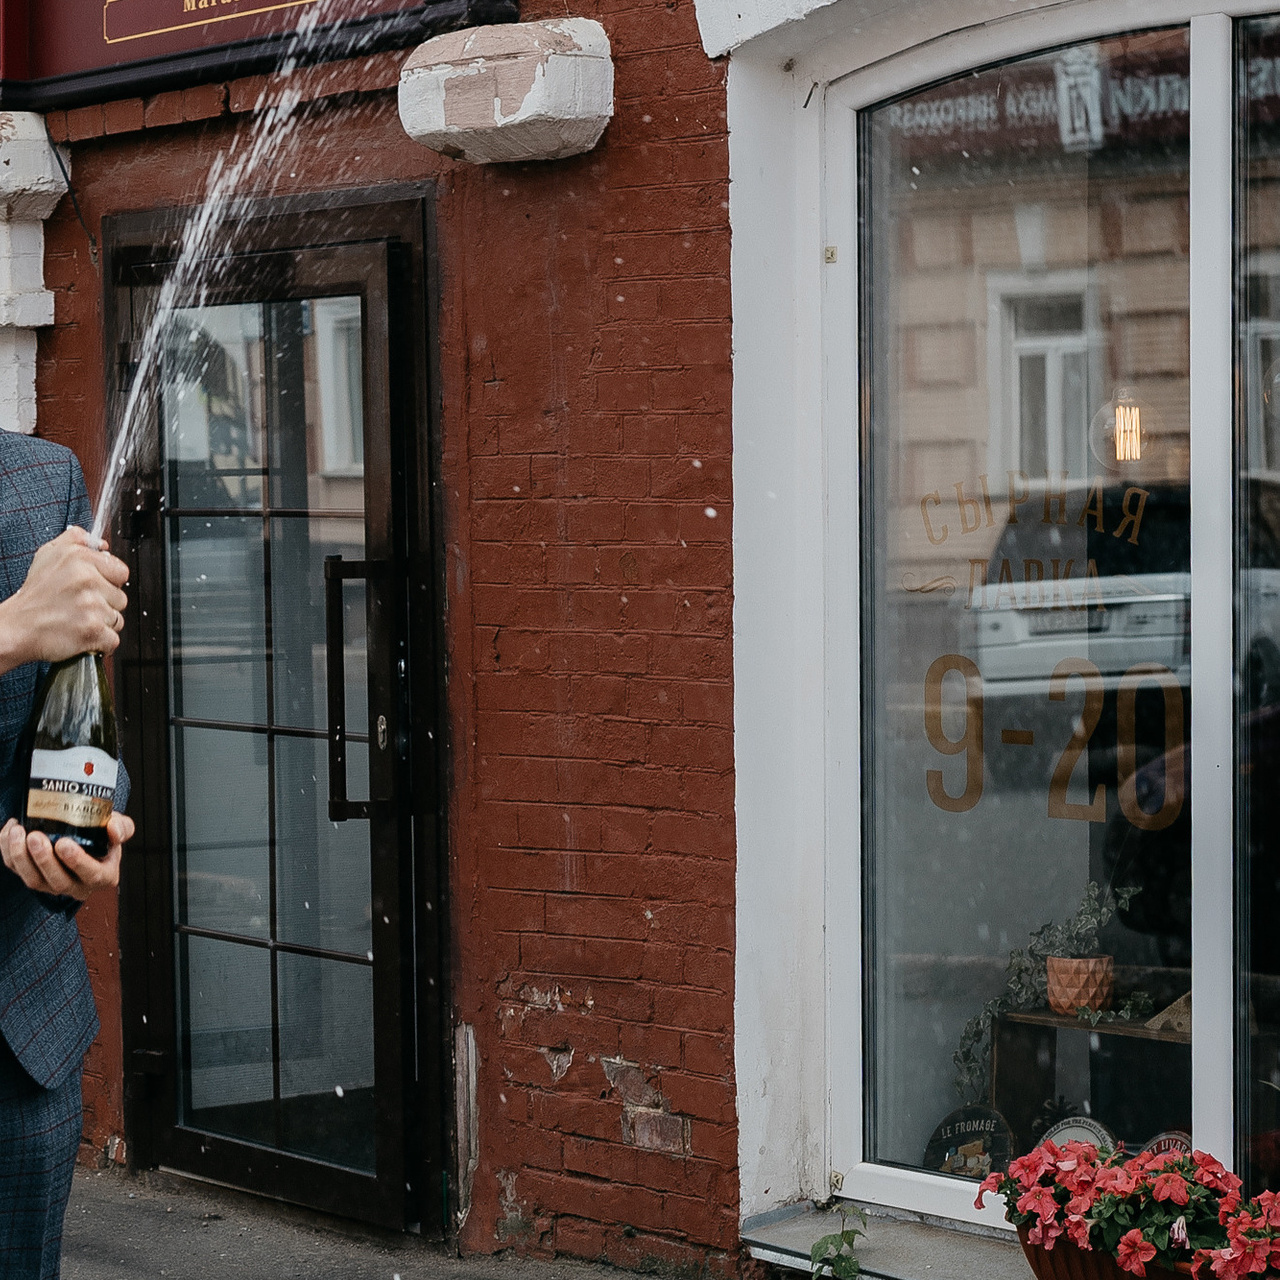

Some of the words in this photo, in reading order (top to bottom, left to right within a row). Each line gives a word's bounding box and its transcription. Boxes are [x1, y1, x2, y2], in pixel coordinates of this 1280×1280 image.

[919, 470, 1150, 546] СЫРНАЯ
[964, 558, 1108, 612] ЛАВКА
[924, 654, 1184, 831] 9-20
[42, 779, 79, 793] SANTO
[64, 803, 102, 815] BIANCO
[941, 1125, 952, 1139] LE
[955, 1120, 997, 1134] FROMAGE
